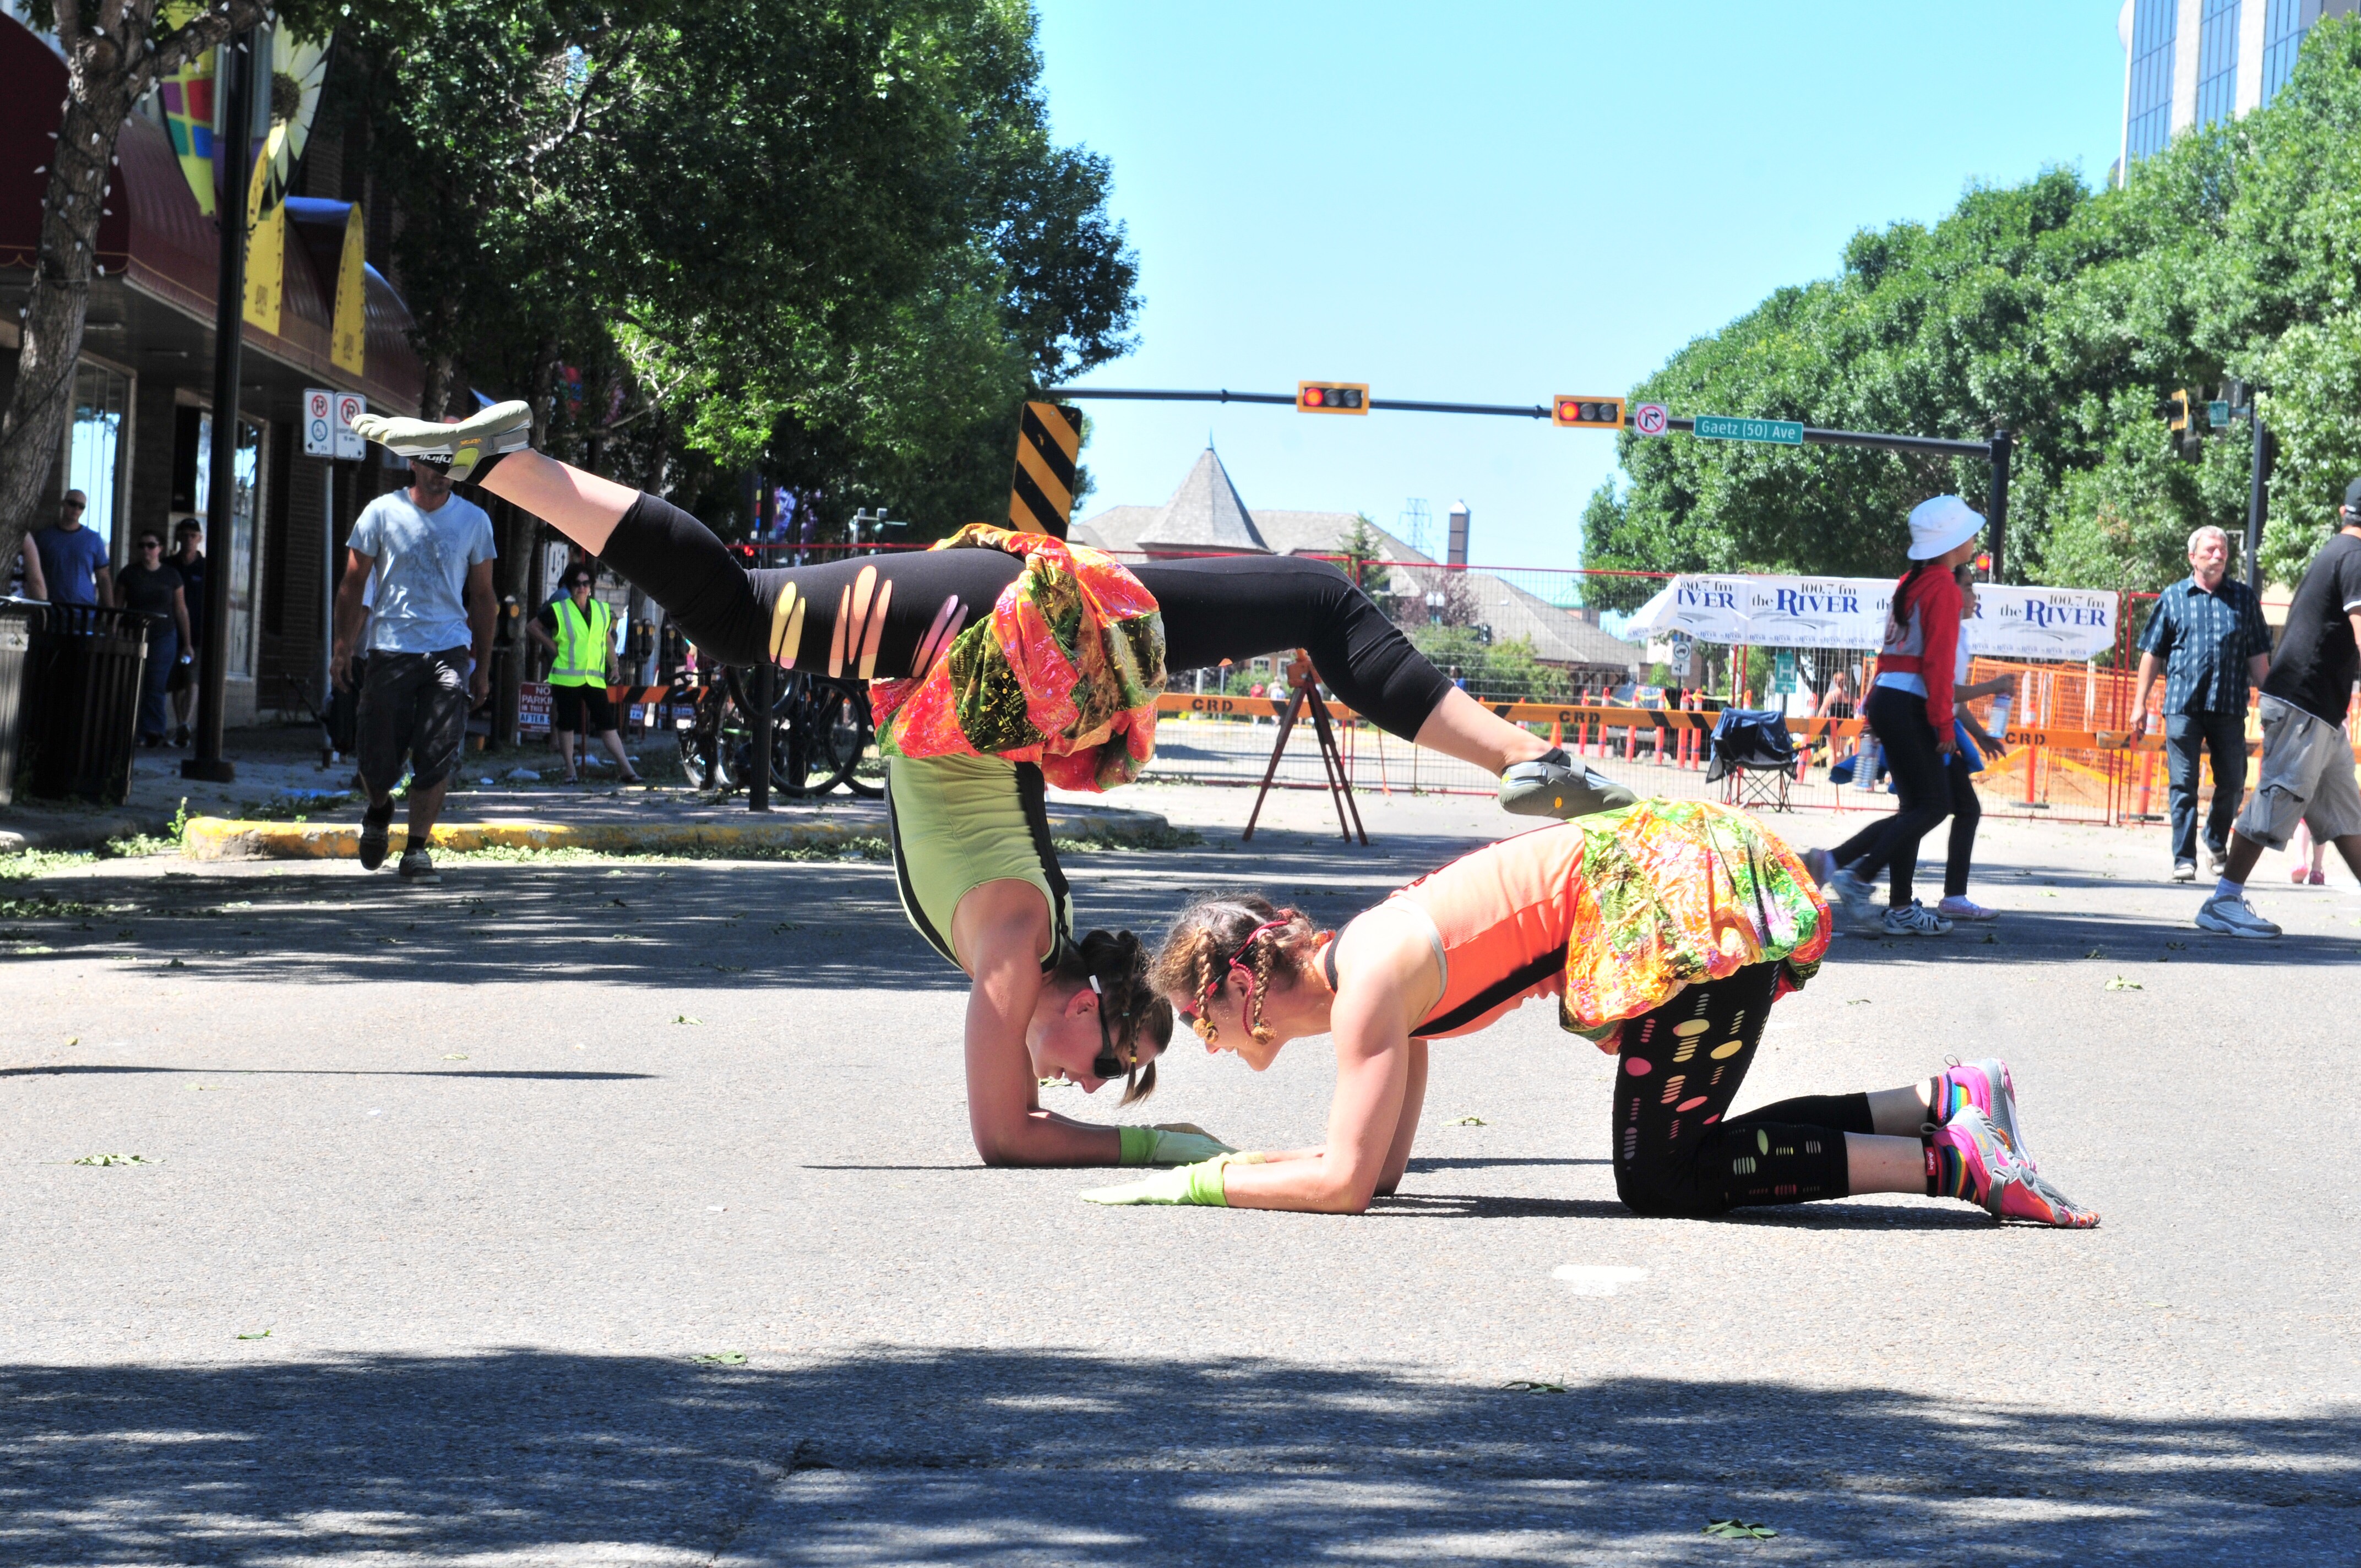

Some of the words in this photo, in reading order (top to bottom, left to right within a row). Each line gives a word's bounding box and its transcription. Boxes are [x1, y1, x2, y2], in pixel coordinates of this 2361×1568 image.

[1701, 420, 1738, 435] Gaetz
[1742, 422, 1767, 439] (50)
[1772, 426, 1796, 439] Ave
[1715, 581, 1732, 591] fm
[1801, 582, 1834, 595] 100.7
[1839, 584, 1856, 595] fm
[1753, 594, 1774, 607] the
[1776, 589, 1860, 617] RIVER
[1876, 598, 1889, 610] th
[2049, 594, 2083, 607] 100.7
[2087, 596, 2104, 608] fm
[2000, 604, 2022, 617] the
[2025, 599, 2107, 628] RIVER
[1778, 663, 1795, 680] H
[536, 686, 551, 695] NO
[1192, 698, 1233, 712] CRD
[521, 714, 545, 723] AFTER
[1559, 710, 1601, 724] CRD
[2005, 732, 2046, 745] CRD
